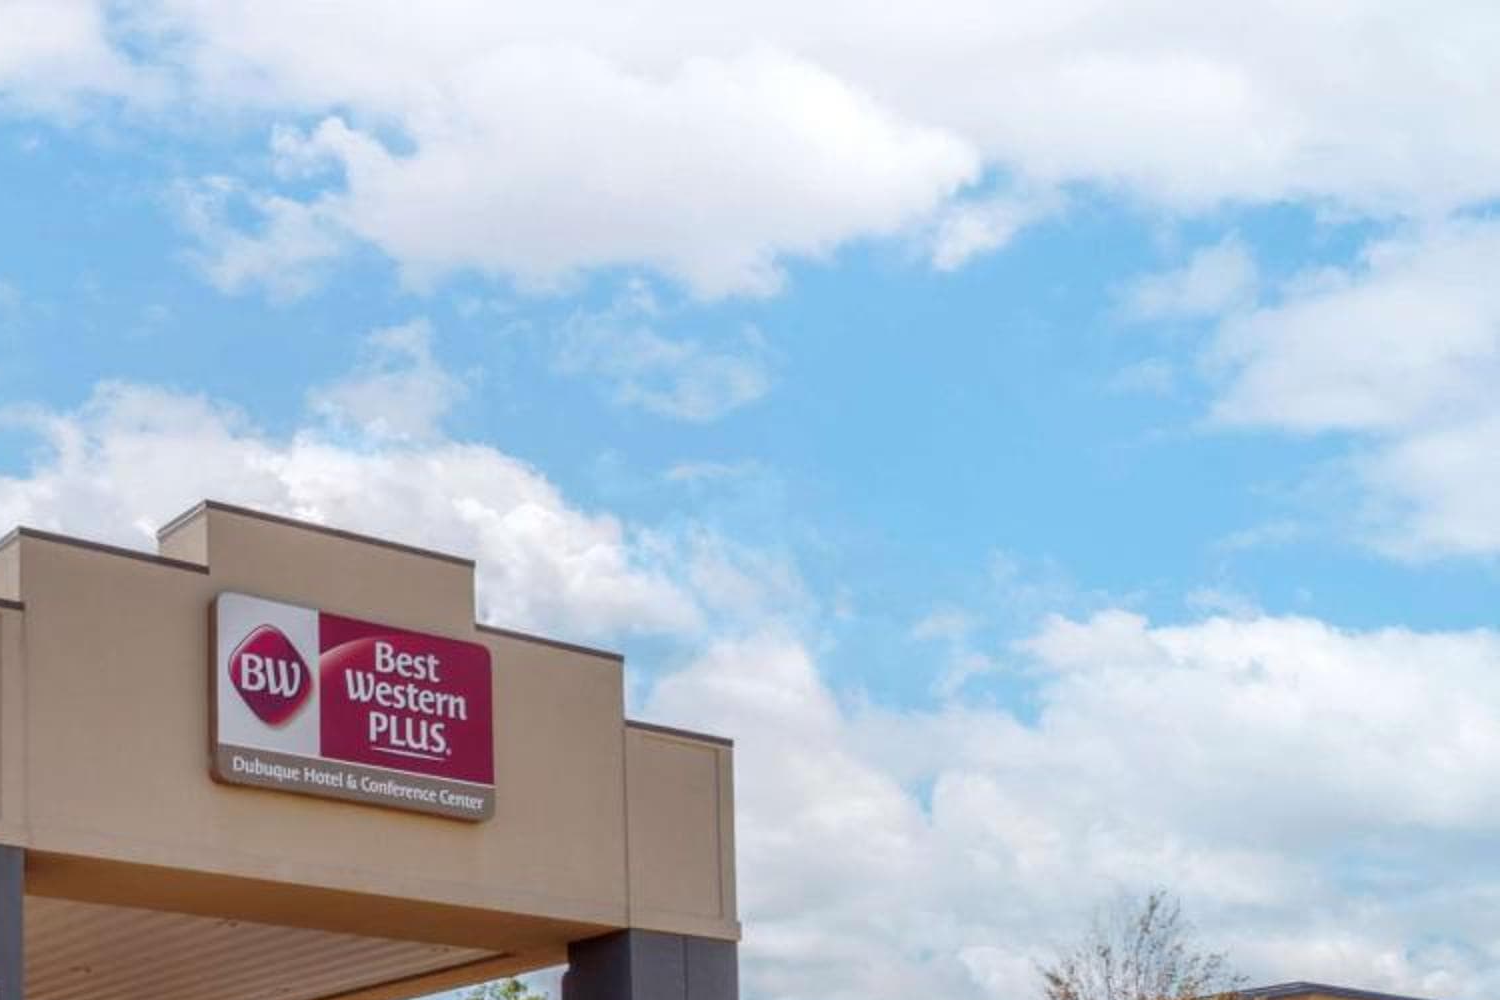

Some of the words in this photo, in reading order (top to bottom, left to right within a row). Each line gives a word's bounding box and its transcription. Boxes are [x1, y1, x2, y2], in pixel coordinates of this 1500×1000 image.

[240, 652, 300, 698] BW
[374, 641, 441, 682] Best
[345, 668, 468, 720] Western
[232, 755, 301, 782] Dubuque
[303, 767, 343, 788] Hotel
[346, 773, 357, 790] &
[361, 776, 437, 802] Conference
[439, 789, 484, 809] Center
